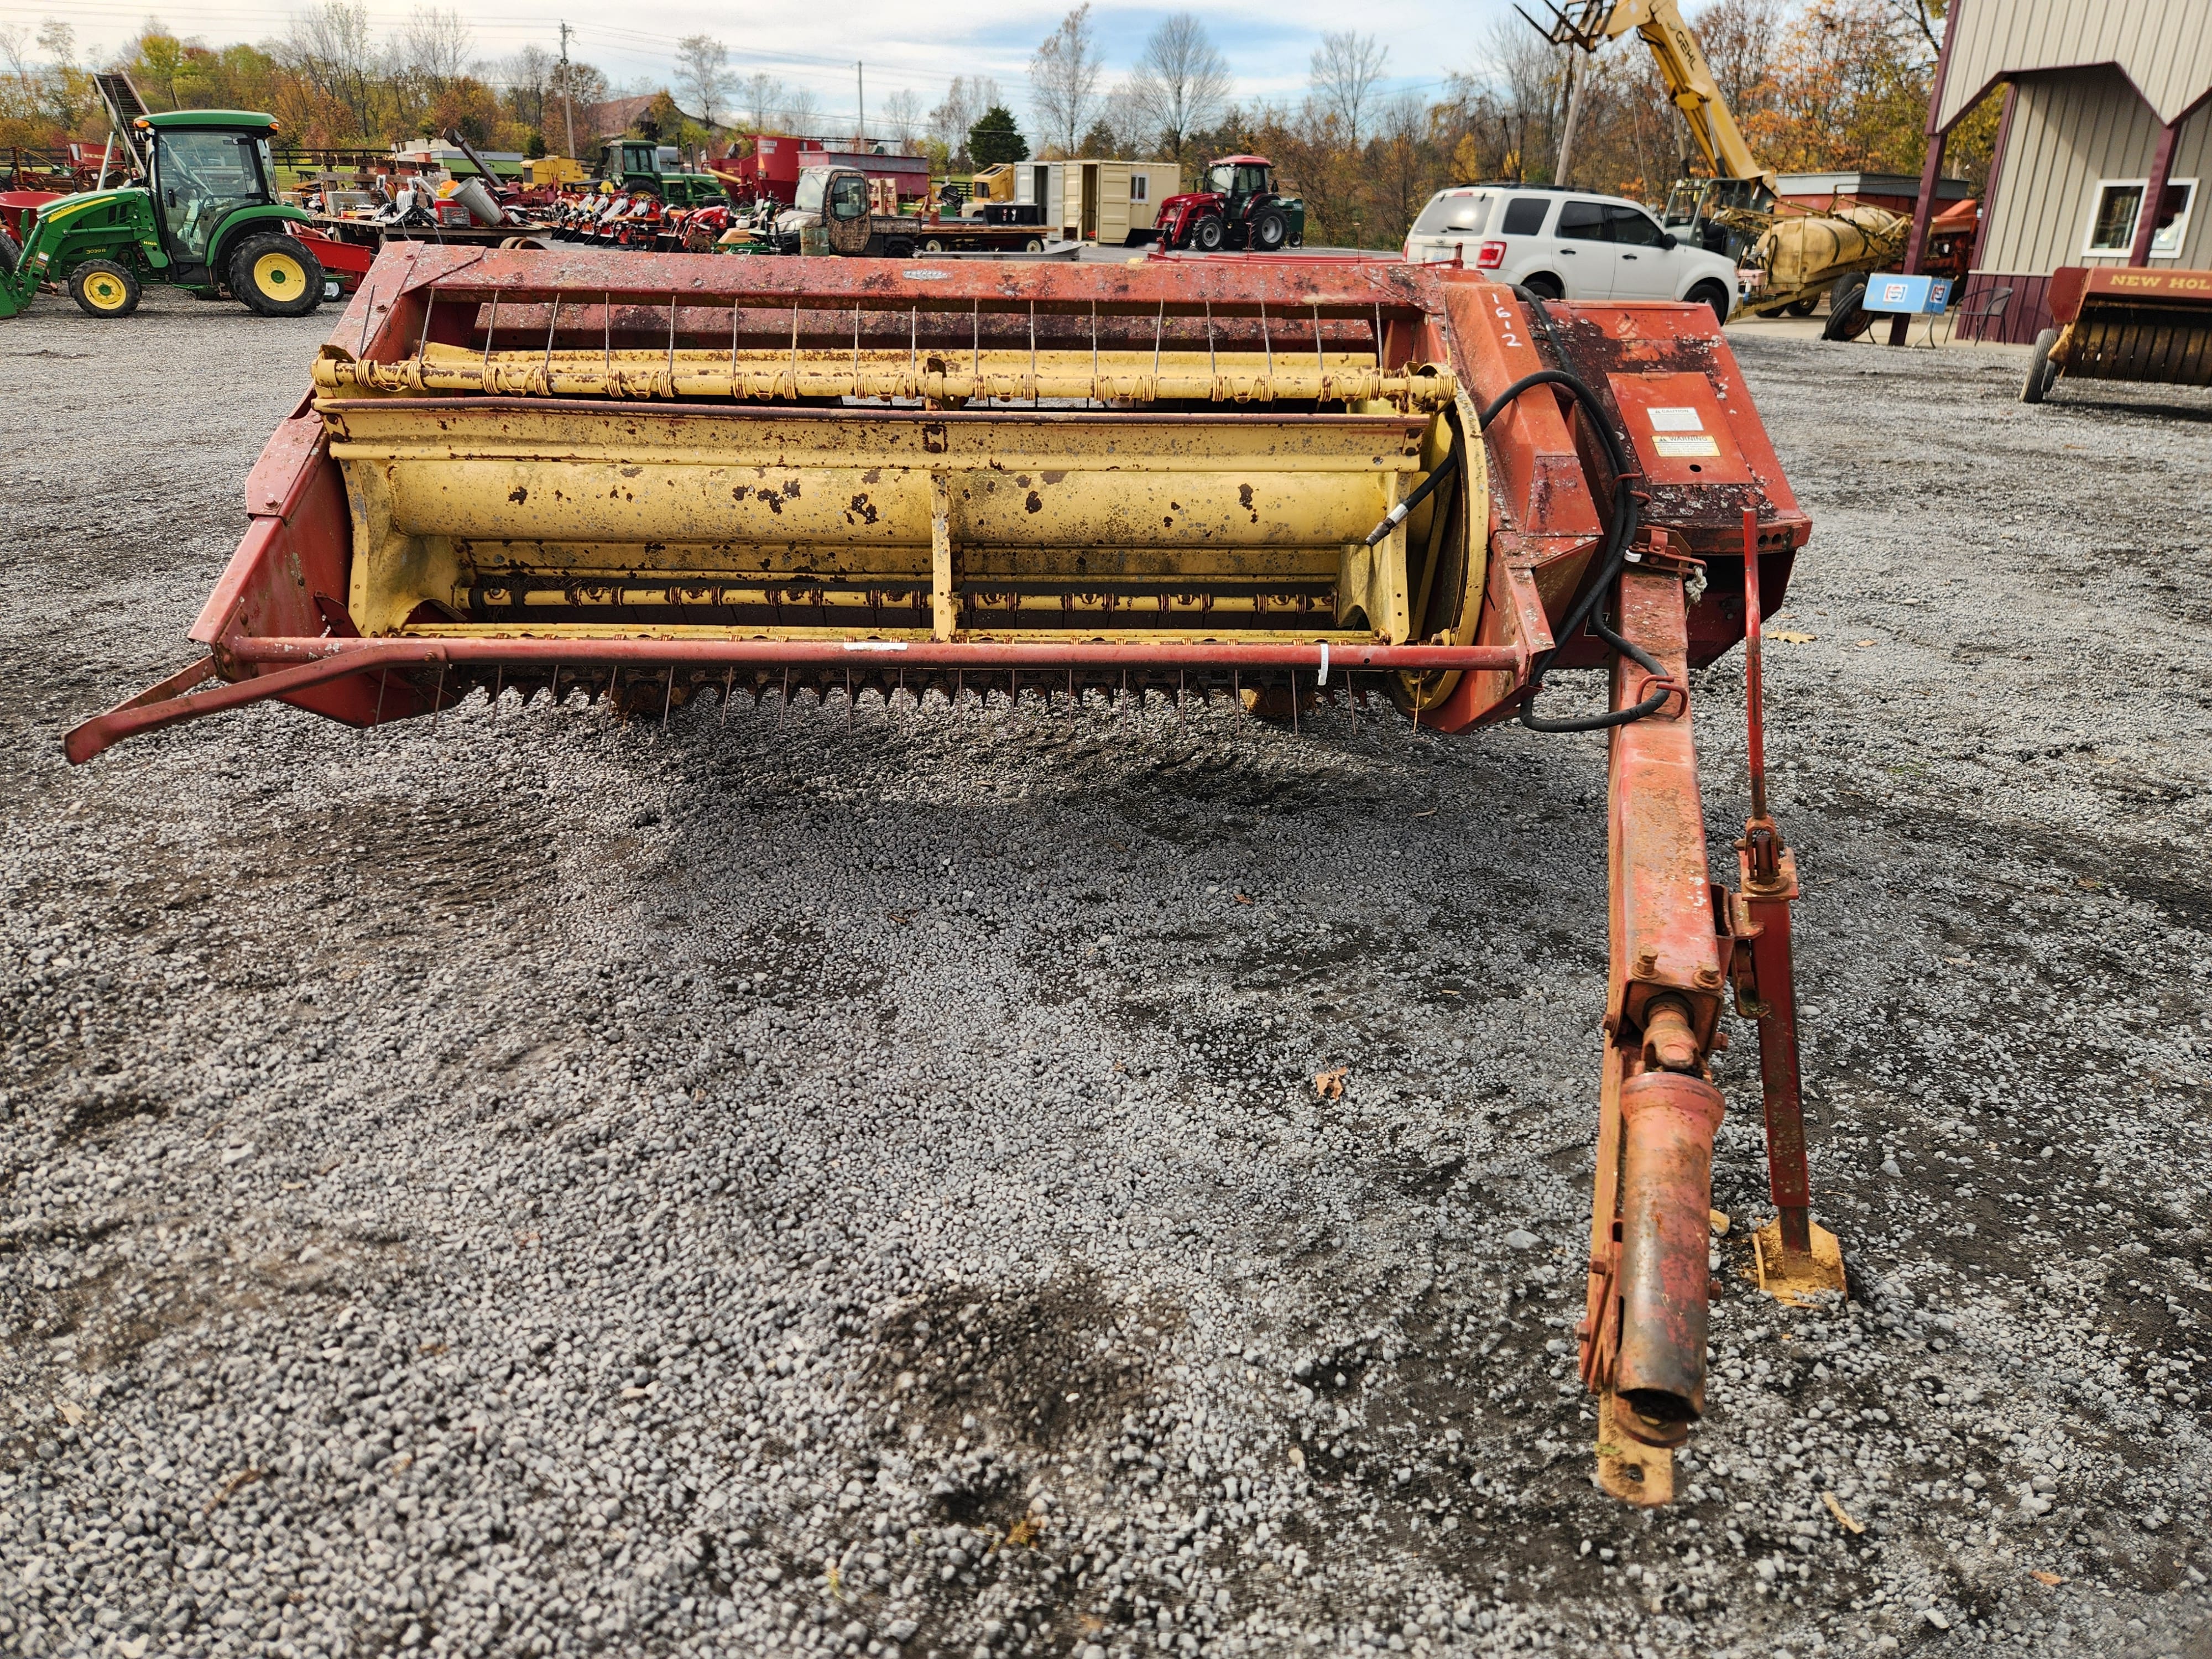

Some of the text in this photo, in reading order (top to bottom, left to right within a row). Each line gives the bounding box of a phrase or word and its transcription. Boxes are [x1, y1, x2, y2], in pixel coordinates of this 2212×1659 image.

[1676, 30, 1695, 71] GEHL
[2110, 274, 2211, 290] NEW HOL
